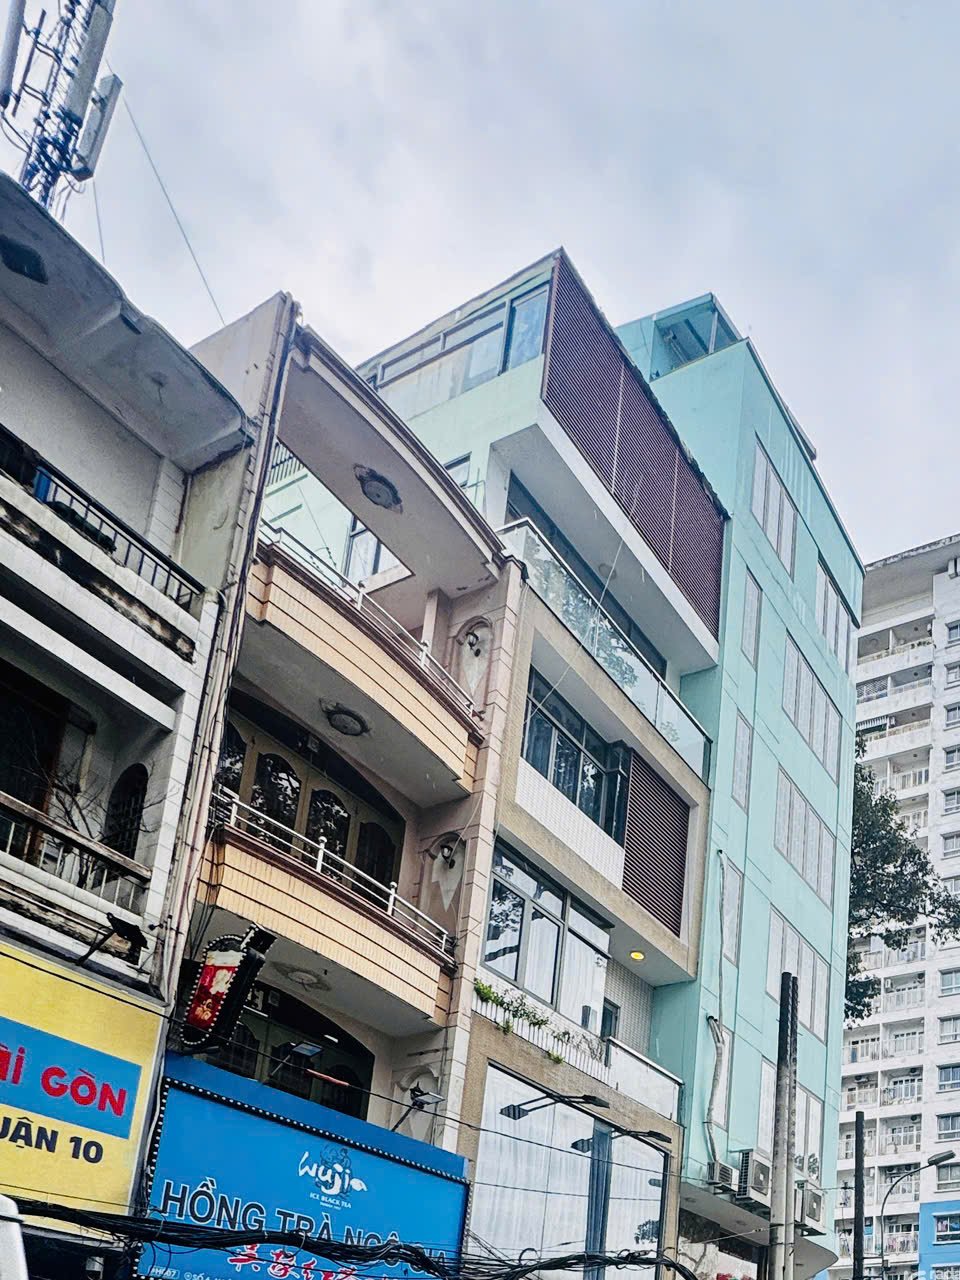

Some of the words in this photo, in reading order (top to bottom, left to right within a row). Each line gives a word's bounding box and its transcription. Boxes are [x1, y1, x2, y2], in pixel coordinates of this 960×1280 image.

[41, 1068, 126, 1116] GÒN
[70, 1136, 104, 1164] 10
[161, 1177, 266, 1234] HỒNG
[275, 1208, 333, 1241] TRÀ
